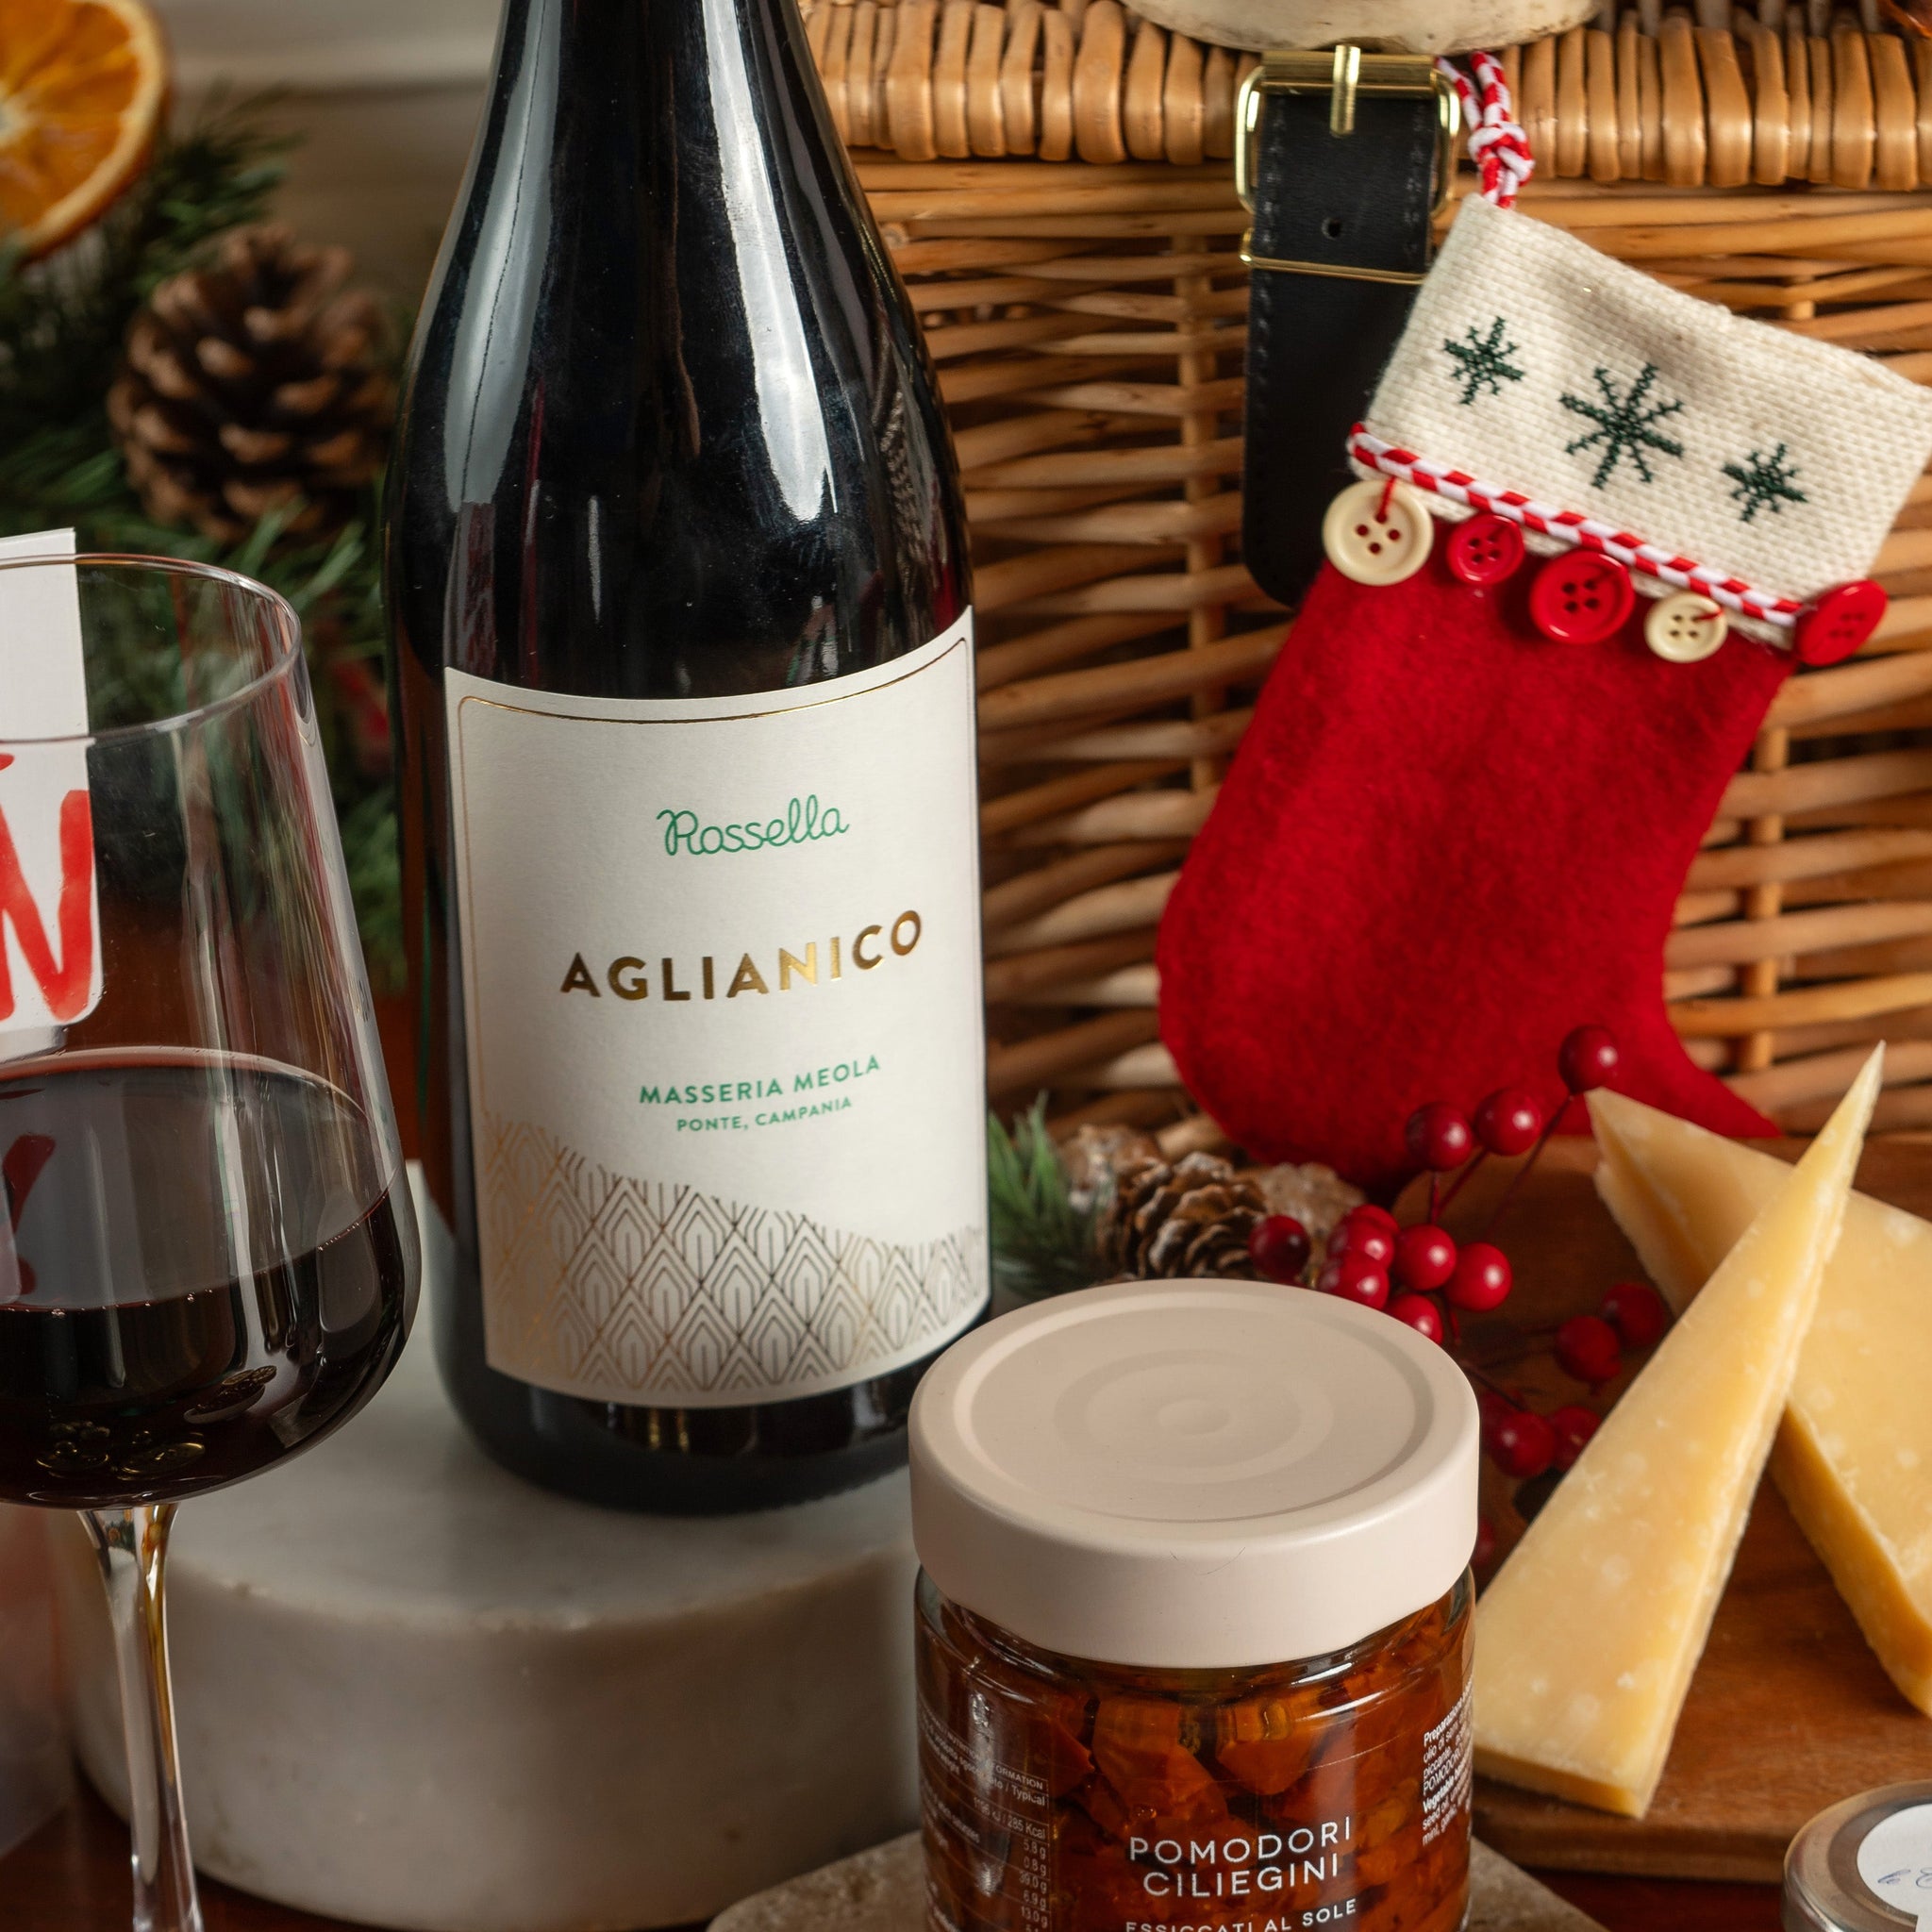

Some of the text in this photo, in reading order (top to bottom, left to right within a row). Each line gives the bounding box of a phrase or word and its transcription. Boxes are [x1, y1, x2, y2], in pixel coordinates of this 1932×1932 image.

[657, 794, 850, 856] Rossella
[560, 909, 922, 1001] AGLIANICO
[640, 1055, 880, 1104] MASSERIA MEOLA
[677, 1096, 852, 1131] PONTE, CAMPANIA
[1011, 1784, 1045, 1807] Typical
[1025, 1823, 1045, 1840] Kcal
[1130, 1816, 1350, 1865] POMODORI
[1040, 1846, 1046, 1860] g
[1040, 1864, 1046, 1877] g
[1143, 1853, 1338, 1897] CILIEGINI
[1264, 1917, 1292, 1932] AL
[1302, 1898, 1356, 1927] SOLE
